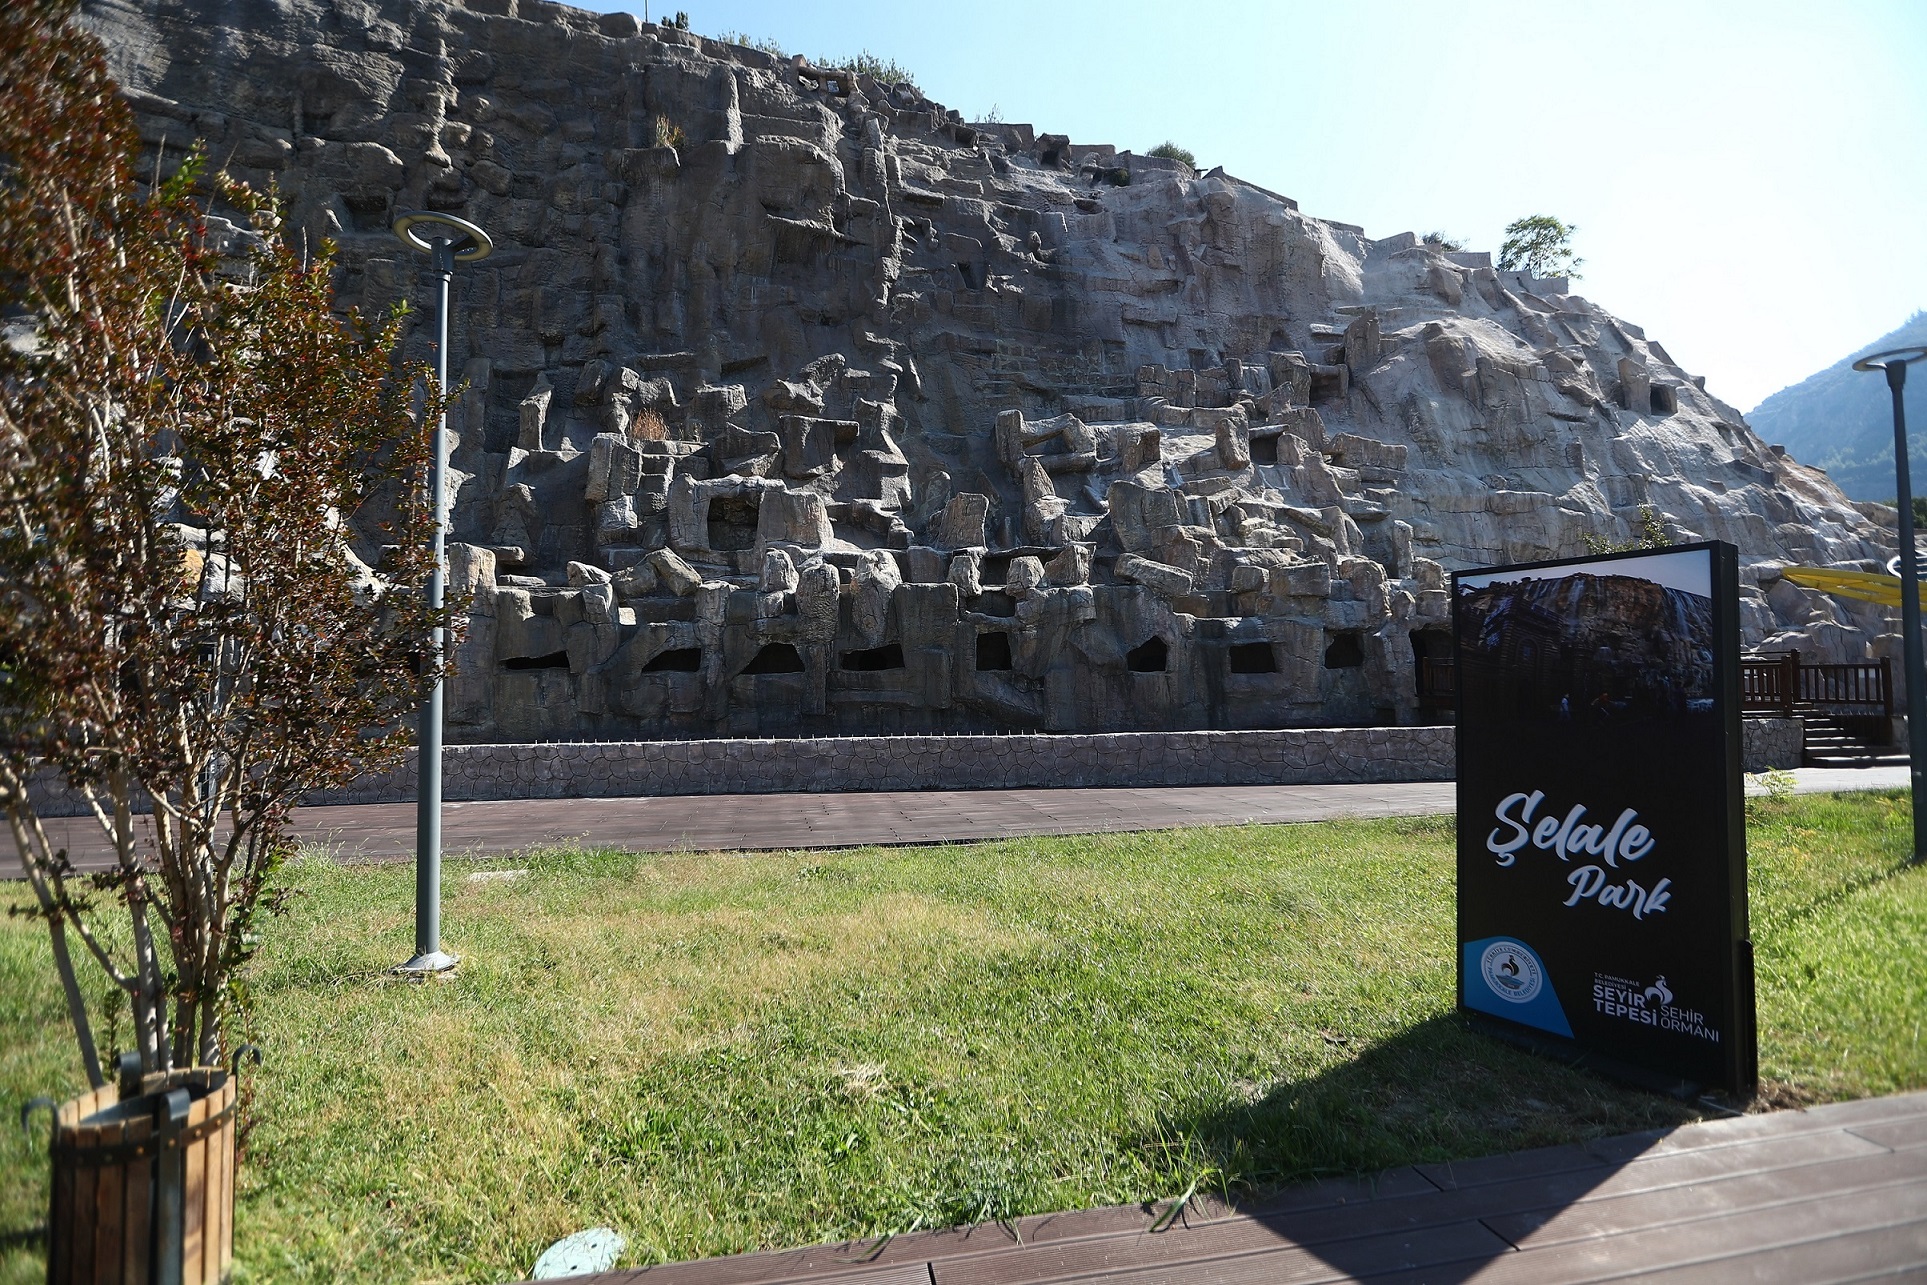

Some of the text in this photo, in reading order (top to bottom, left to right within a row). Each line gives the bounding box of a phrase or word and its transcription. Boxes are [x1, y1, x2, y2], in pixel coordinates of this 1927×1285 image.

[1486, 789, 1656, 868] Şelale
[1562, 864, 1672, 921] Park
[1604, 975, 1640, 987] PAMUKKALE
[1593, 984, 1645, 1008] SEYİR
[1593, 998, 1657, 1026] TEPESİ
[1661, 1017, 1719, 1042] ORMANI
